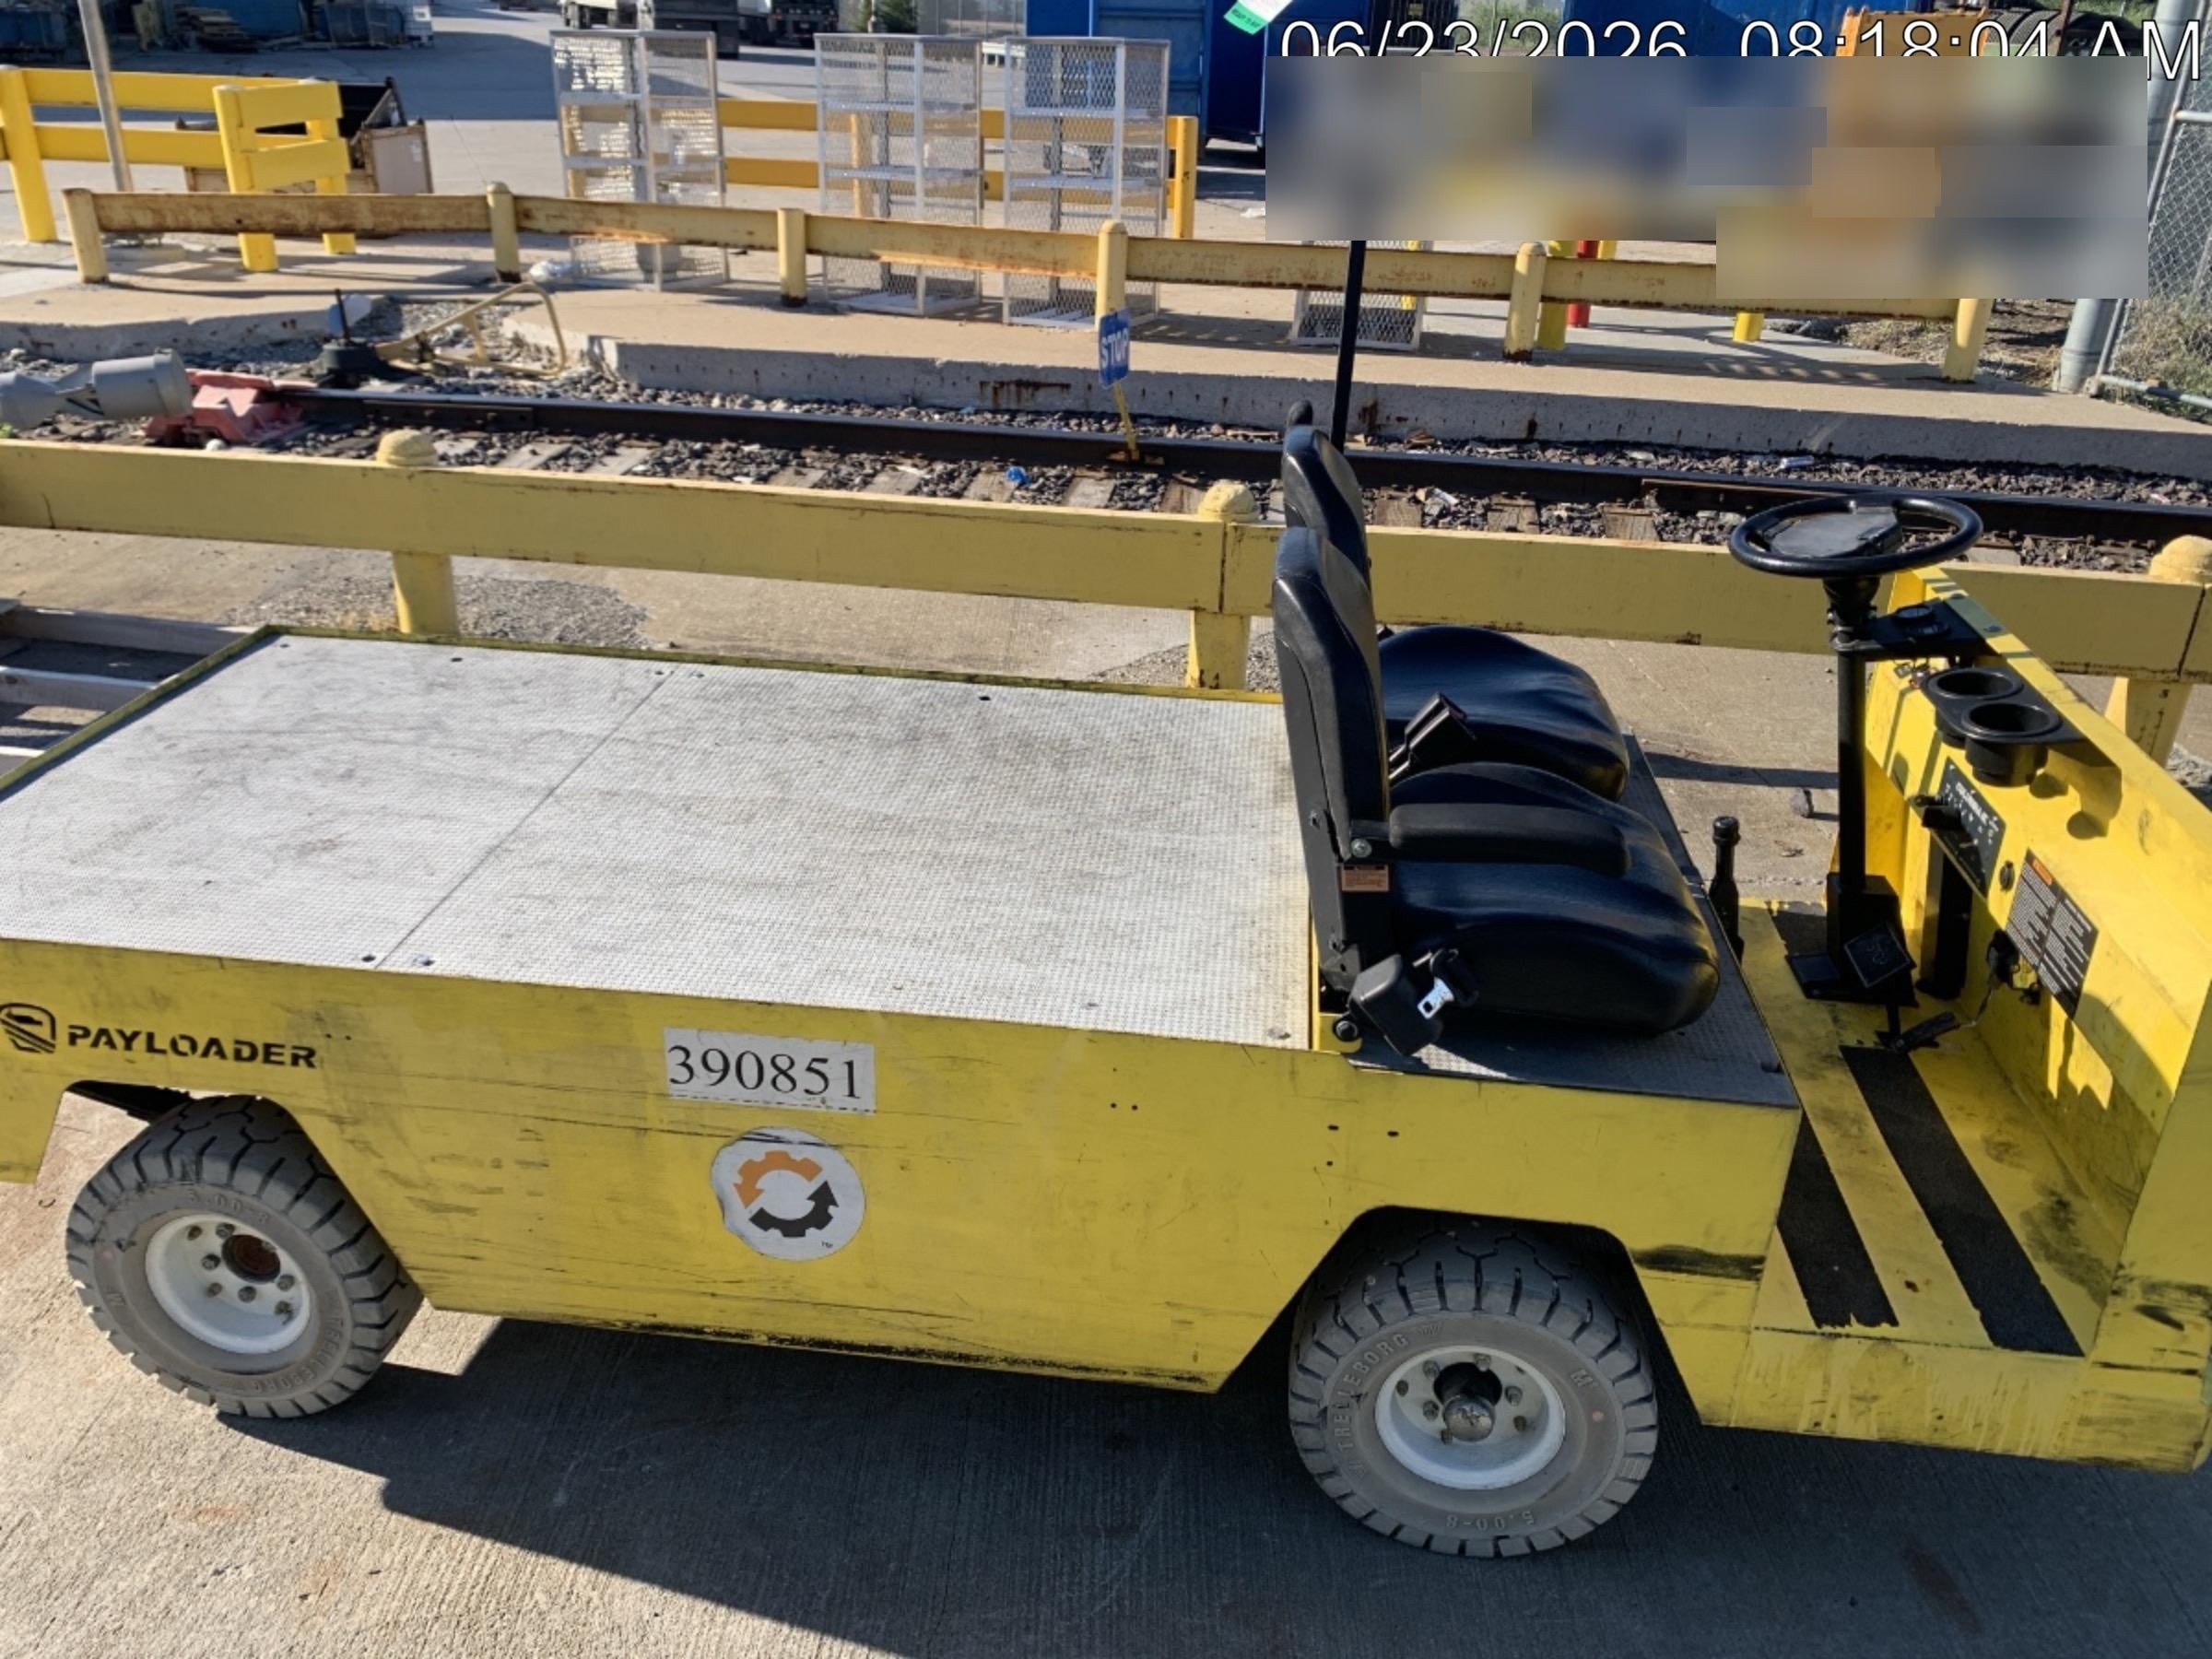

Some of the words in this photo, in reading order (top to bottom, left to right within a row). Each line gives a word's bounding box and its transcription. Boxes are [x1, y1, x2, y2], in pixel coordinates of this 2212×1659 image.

[1100, 328, 1129, 369] STOP
[67, 1024, 318, 1069] PAYLOADER
[667, 1044, 861, 1100] 390851
[1444, 1510, 1535, 1532] 5.00-8
